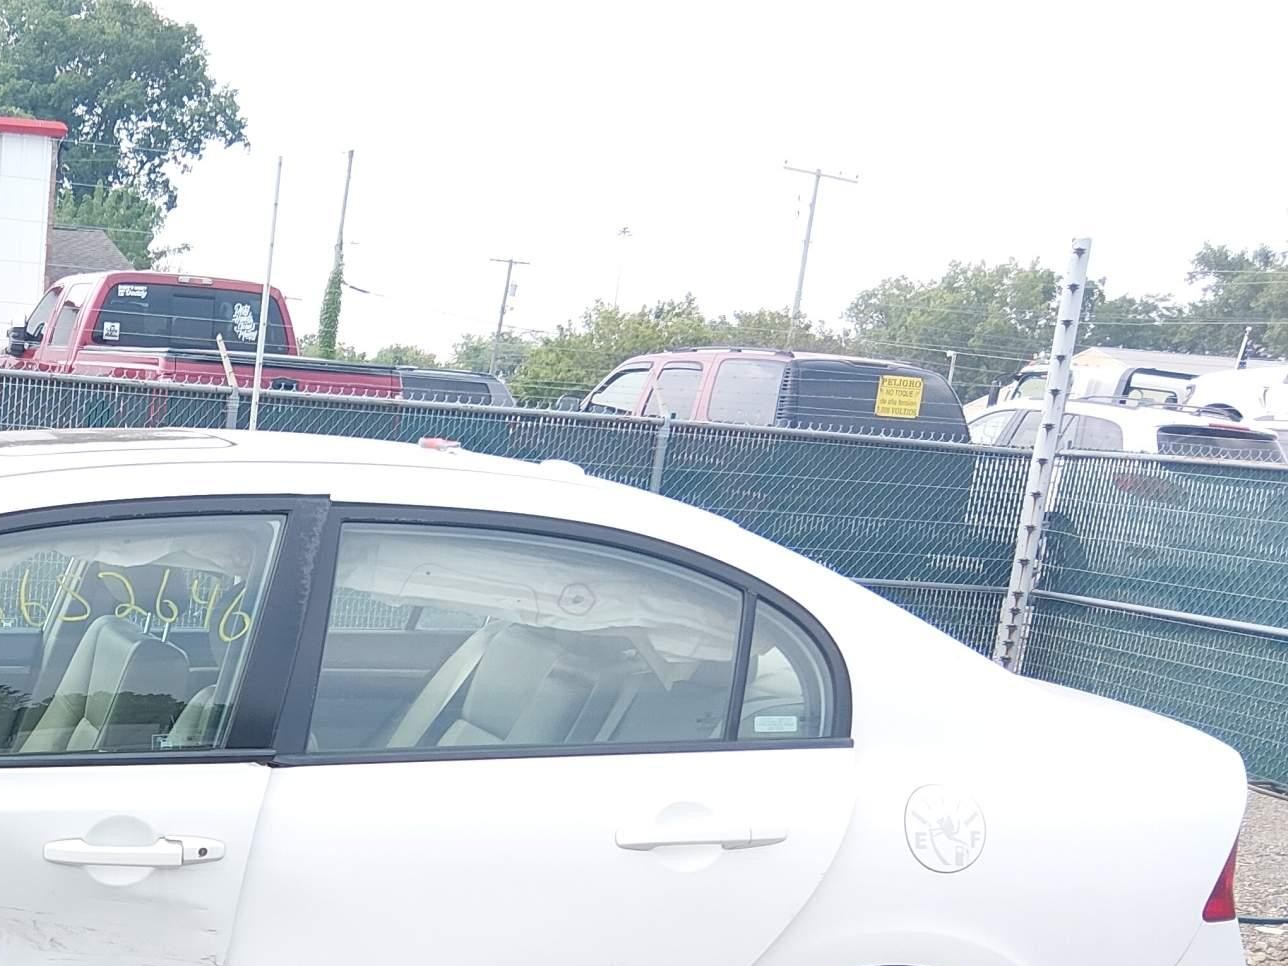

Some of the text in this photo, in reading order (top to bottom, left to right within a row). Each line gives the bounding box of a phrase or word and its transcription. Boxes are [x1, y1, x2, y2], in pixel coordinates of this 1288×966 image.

[881, 378, 922, 388] PELIGRO
[895, 389, 913, 397] TOQUE
[915, 832, 928, 850] E
[970, 830, 982, 849] F
